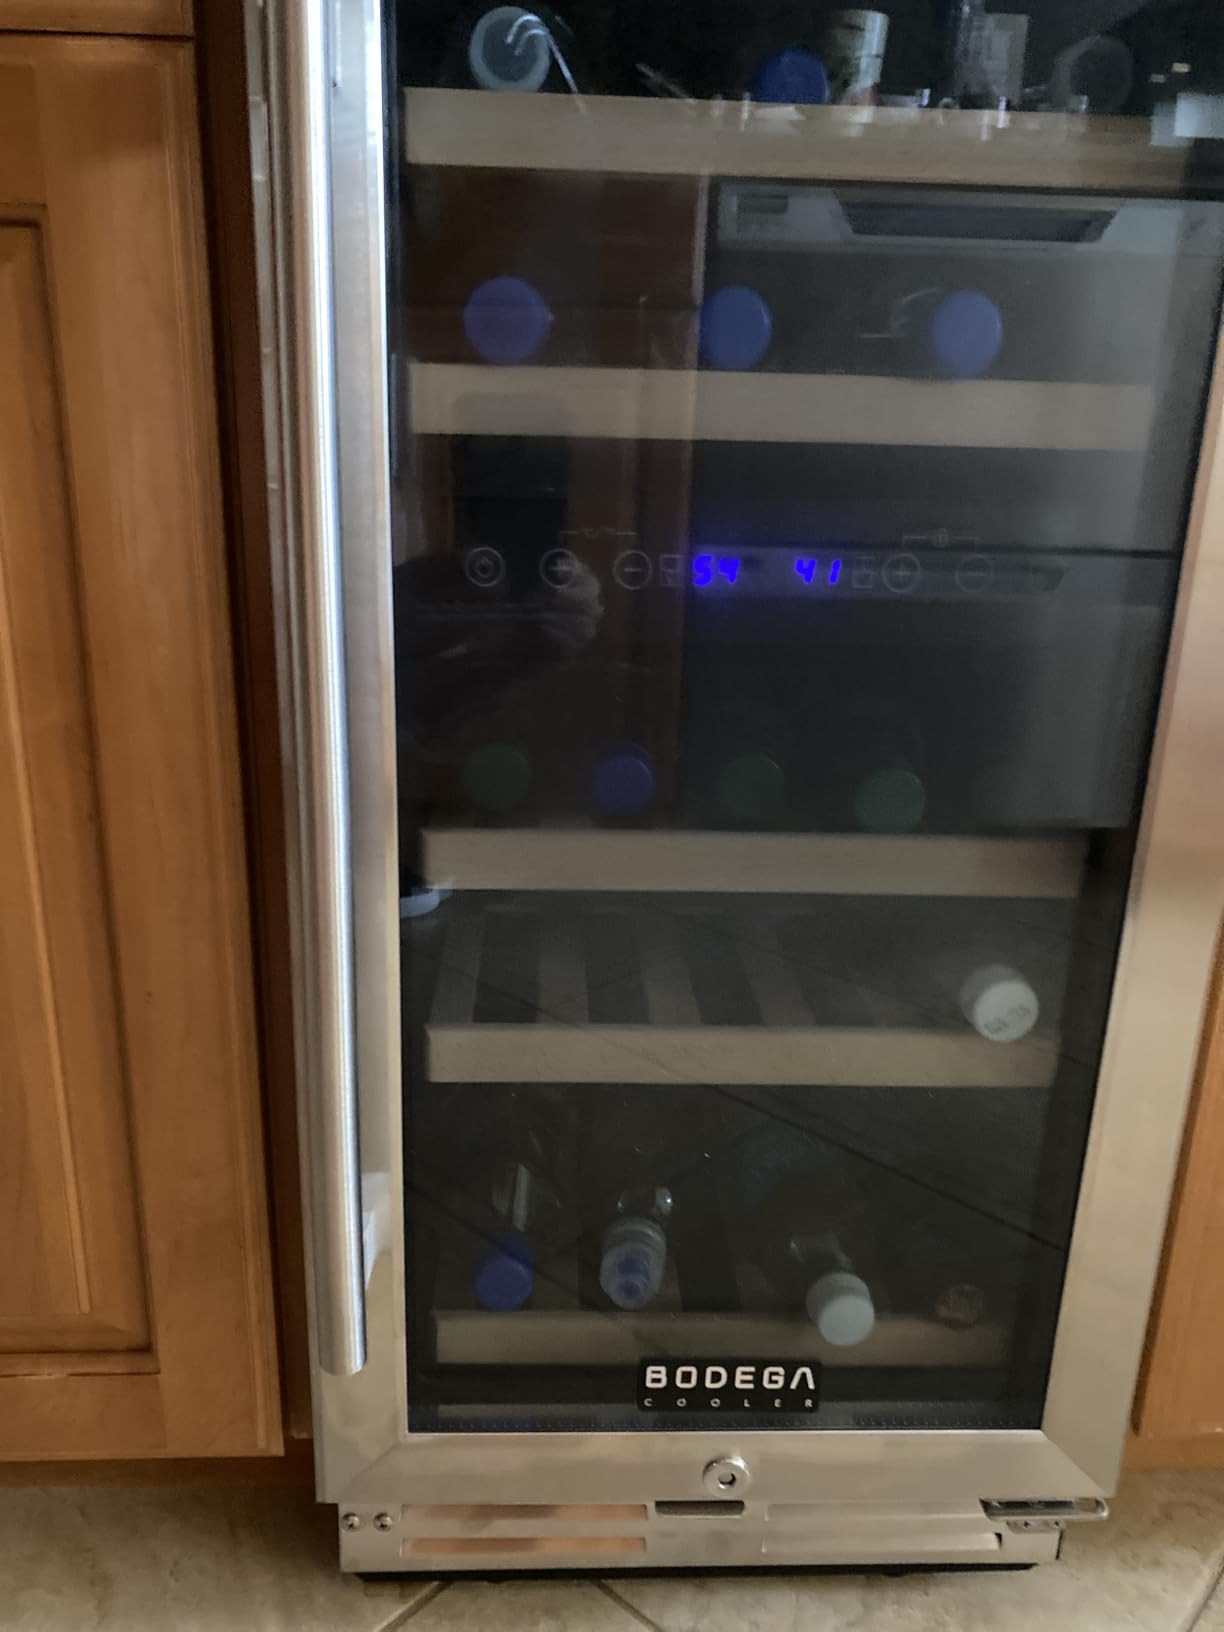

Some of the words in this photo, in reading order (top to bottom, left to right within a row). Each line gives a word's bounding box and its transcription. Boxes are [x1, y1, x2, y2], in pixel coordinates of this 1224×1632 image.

[693, 554, 740, 587] 54
[794, 558, 842, 585] 41
[645, 1365, 816, 1390] BODEGA
[644, 1398, 813, 1407] COOLER
